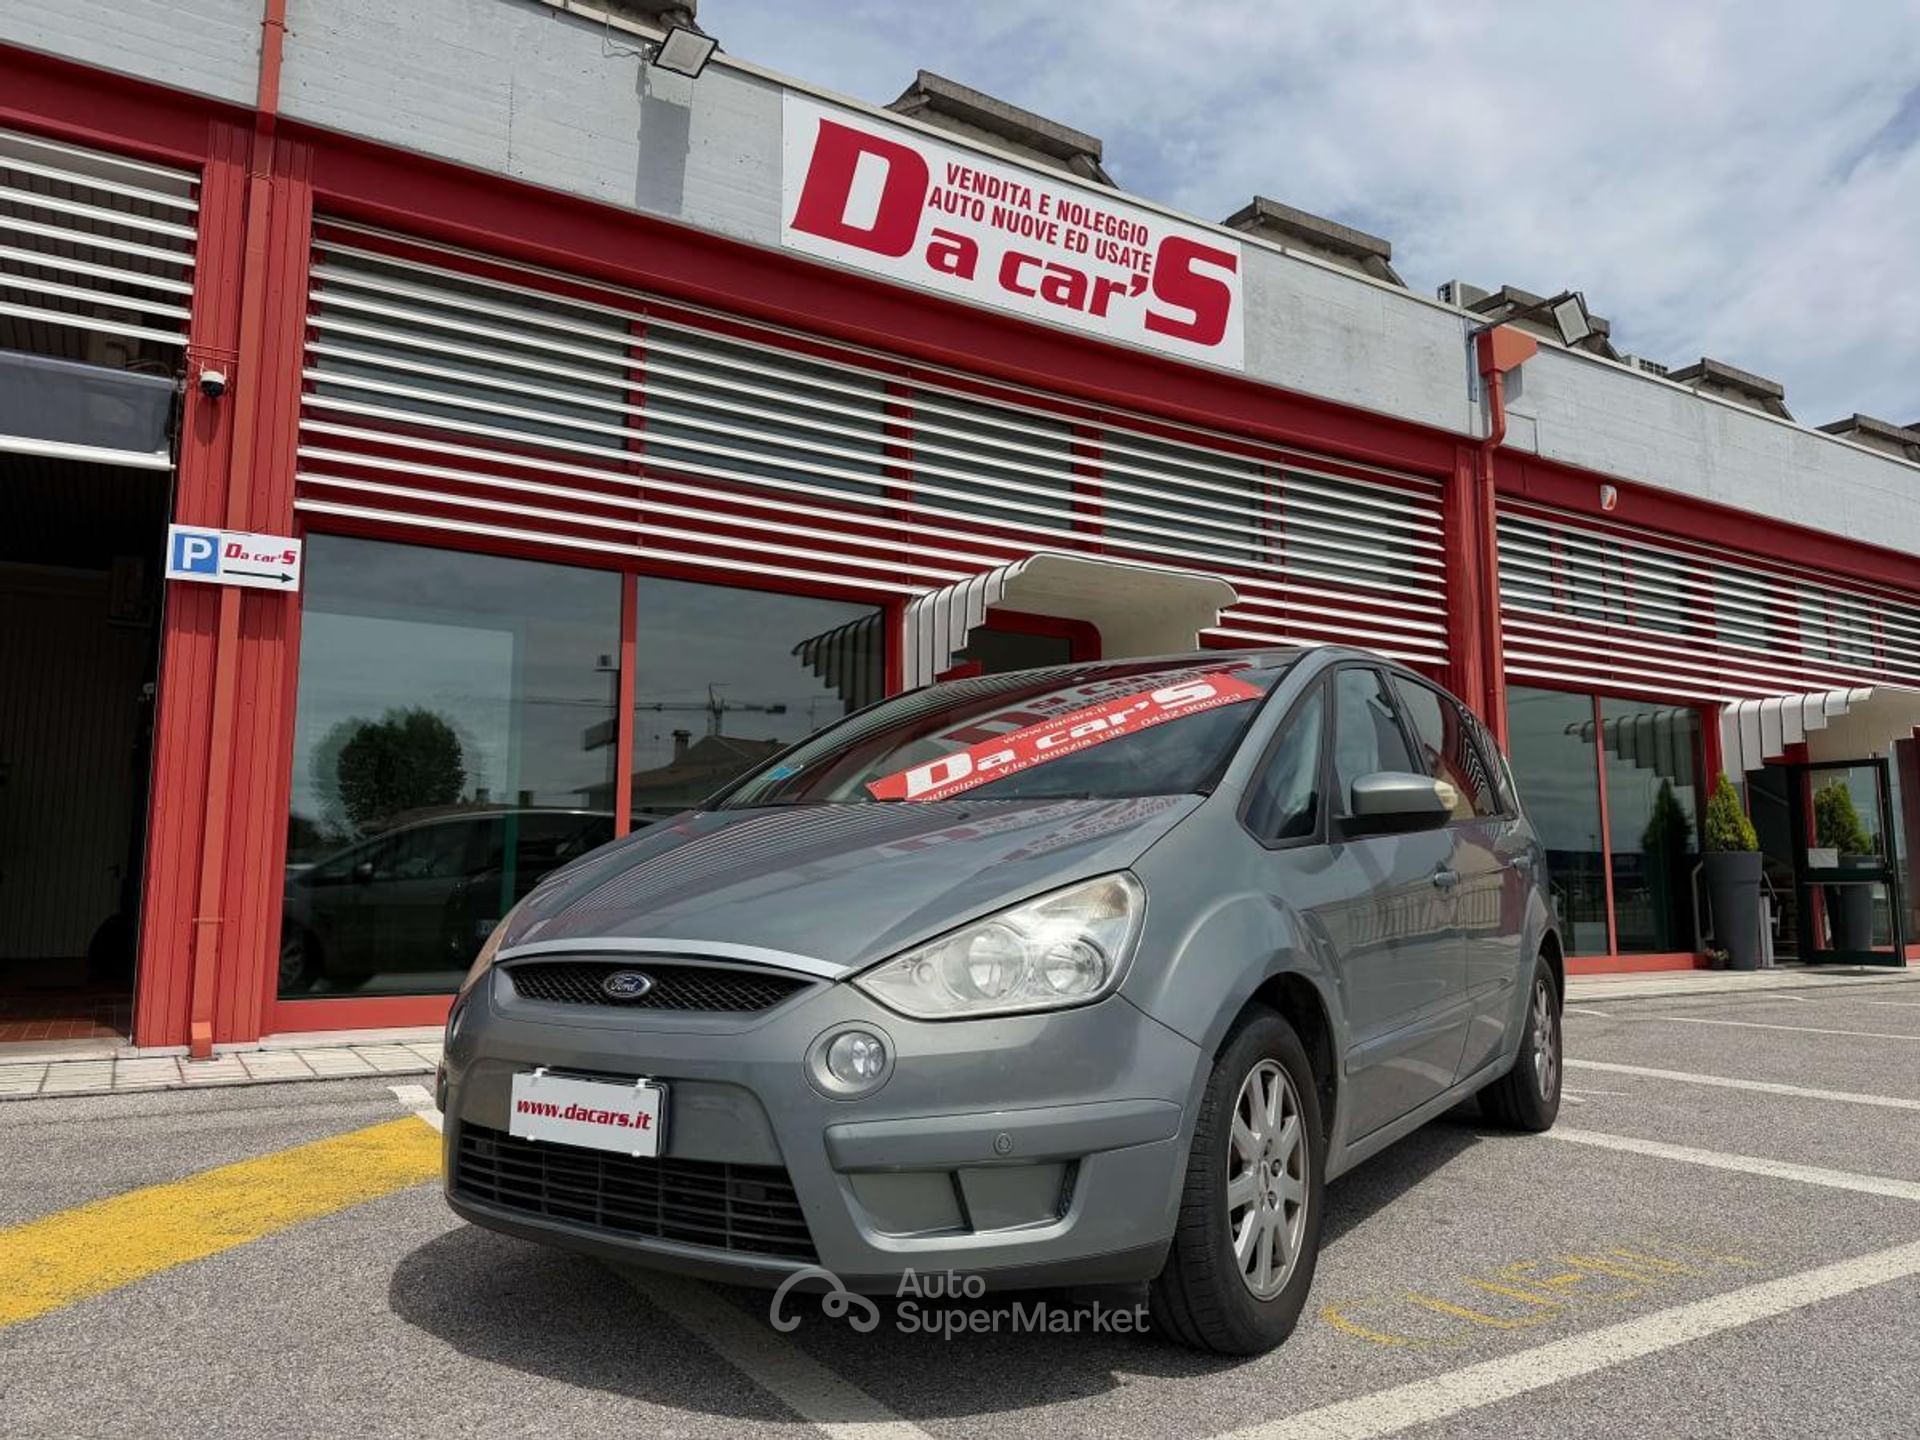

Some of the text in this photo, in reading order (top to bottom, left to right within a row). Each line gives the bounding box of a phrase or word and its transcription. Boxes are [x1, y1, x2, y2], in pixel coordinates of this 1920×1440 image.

[790, 118, 979, 281] Da
[946, 162, 1149, 248] VENDITA E NOLEGGIO
[928, 186, 1152, 275] AUTO NUOVE ED USATE
[182, 537, 212, 569] P
[224, 543, 249, 560] Da
[1030, 738, 1092, 763] Venezia
[905, 749, 1016, 798] Da
[517, 1099, 652, 1130] www.dacars.it
